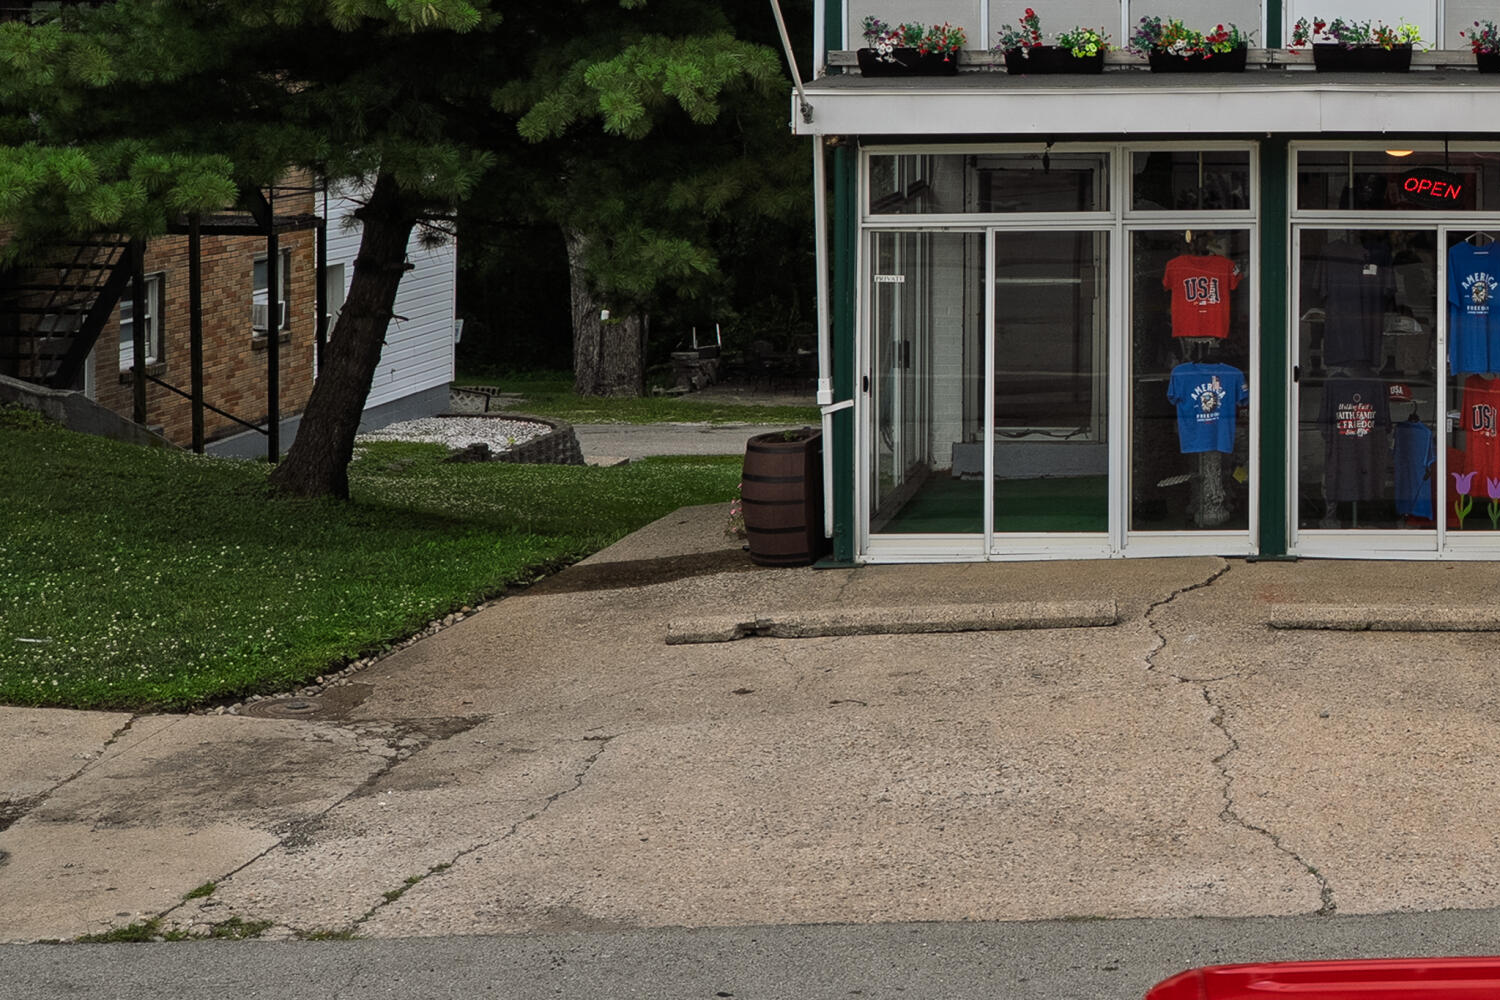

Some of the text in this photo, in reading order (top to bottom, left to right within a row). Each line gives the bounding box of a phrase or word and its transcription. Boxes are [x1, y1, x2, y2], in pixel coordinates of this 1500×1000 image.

[1404, 177, 1461, 200] OPEN
[1183, 276, 1221, 304] USA
[1461, 272, 1498, 290] AMERICA
[1390, 385, 1404, 395] USA
